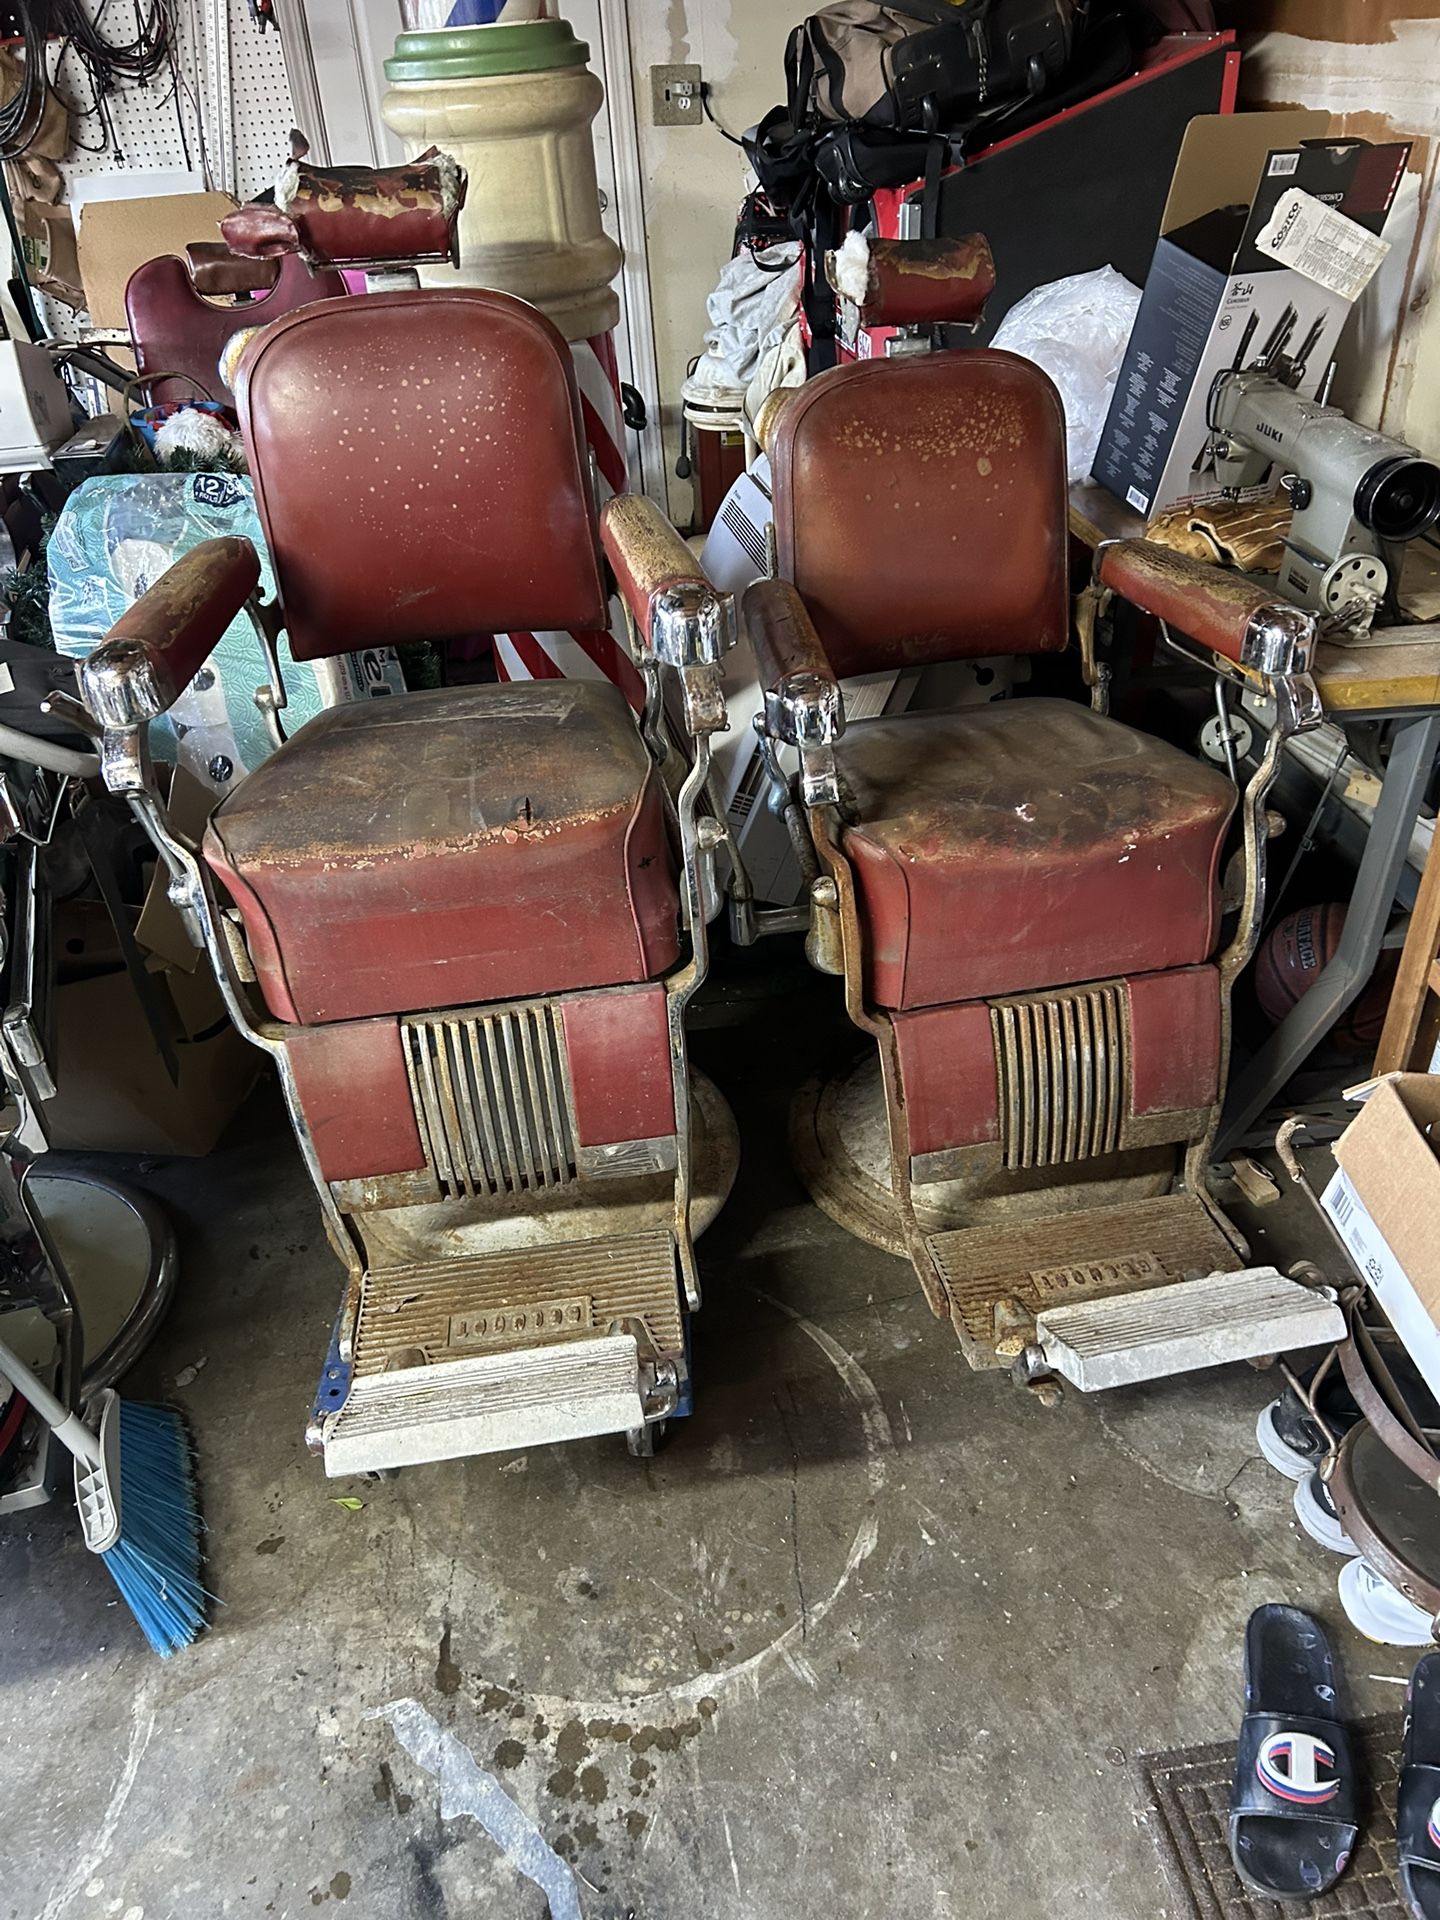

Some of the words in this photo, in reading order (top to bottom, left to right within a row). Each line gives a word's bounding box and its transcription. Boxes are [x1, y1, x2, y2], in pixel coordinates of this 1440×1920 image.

[1271, 202, 1299, 249] COSTCO
[1255, 422, 1283, 444] JUKI
[198, 476, 220, 497] 12
